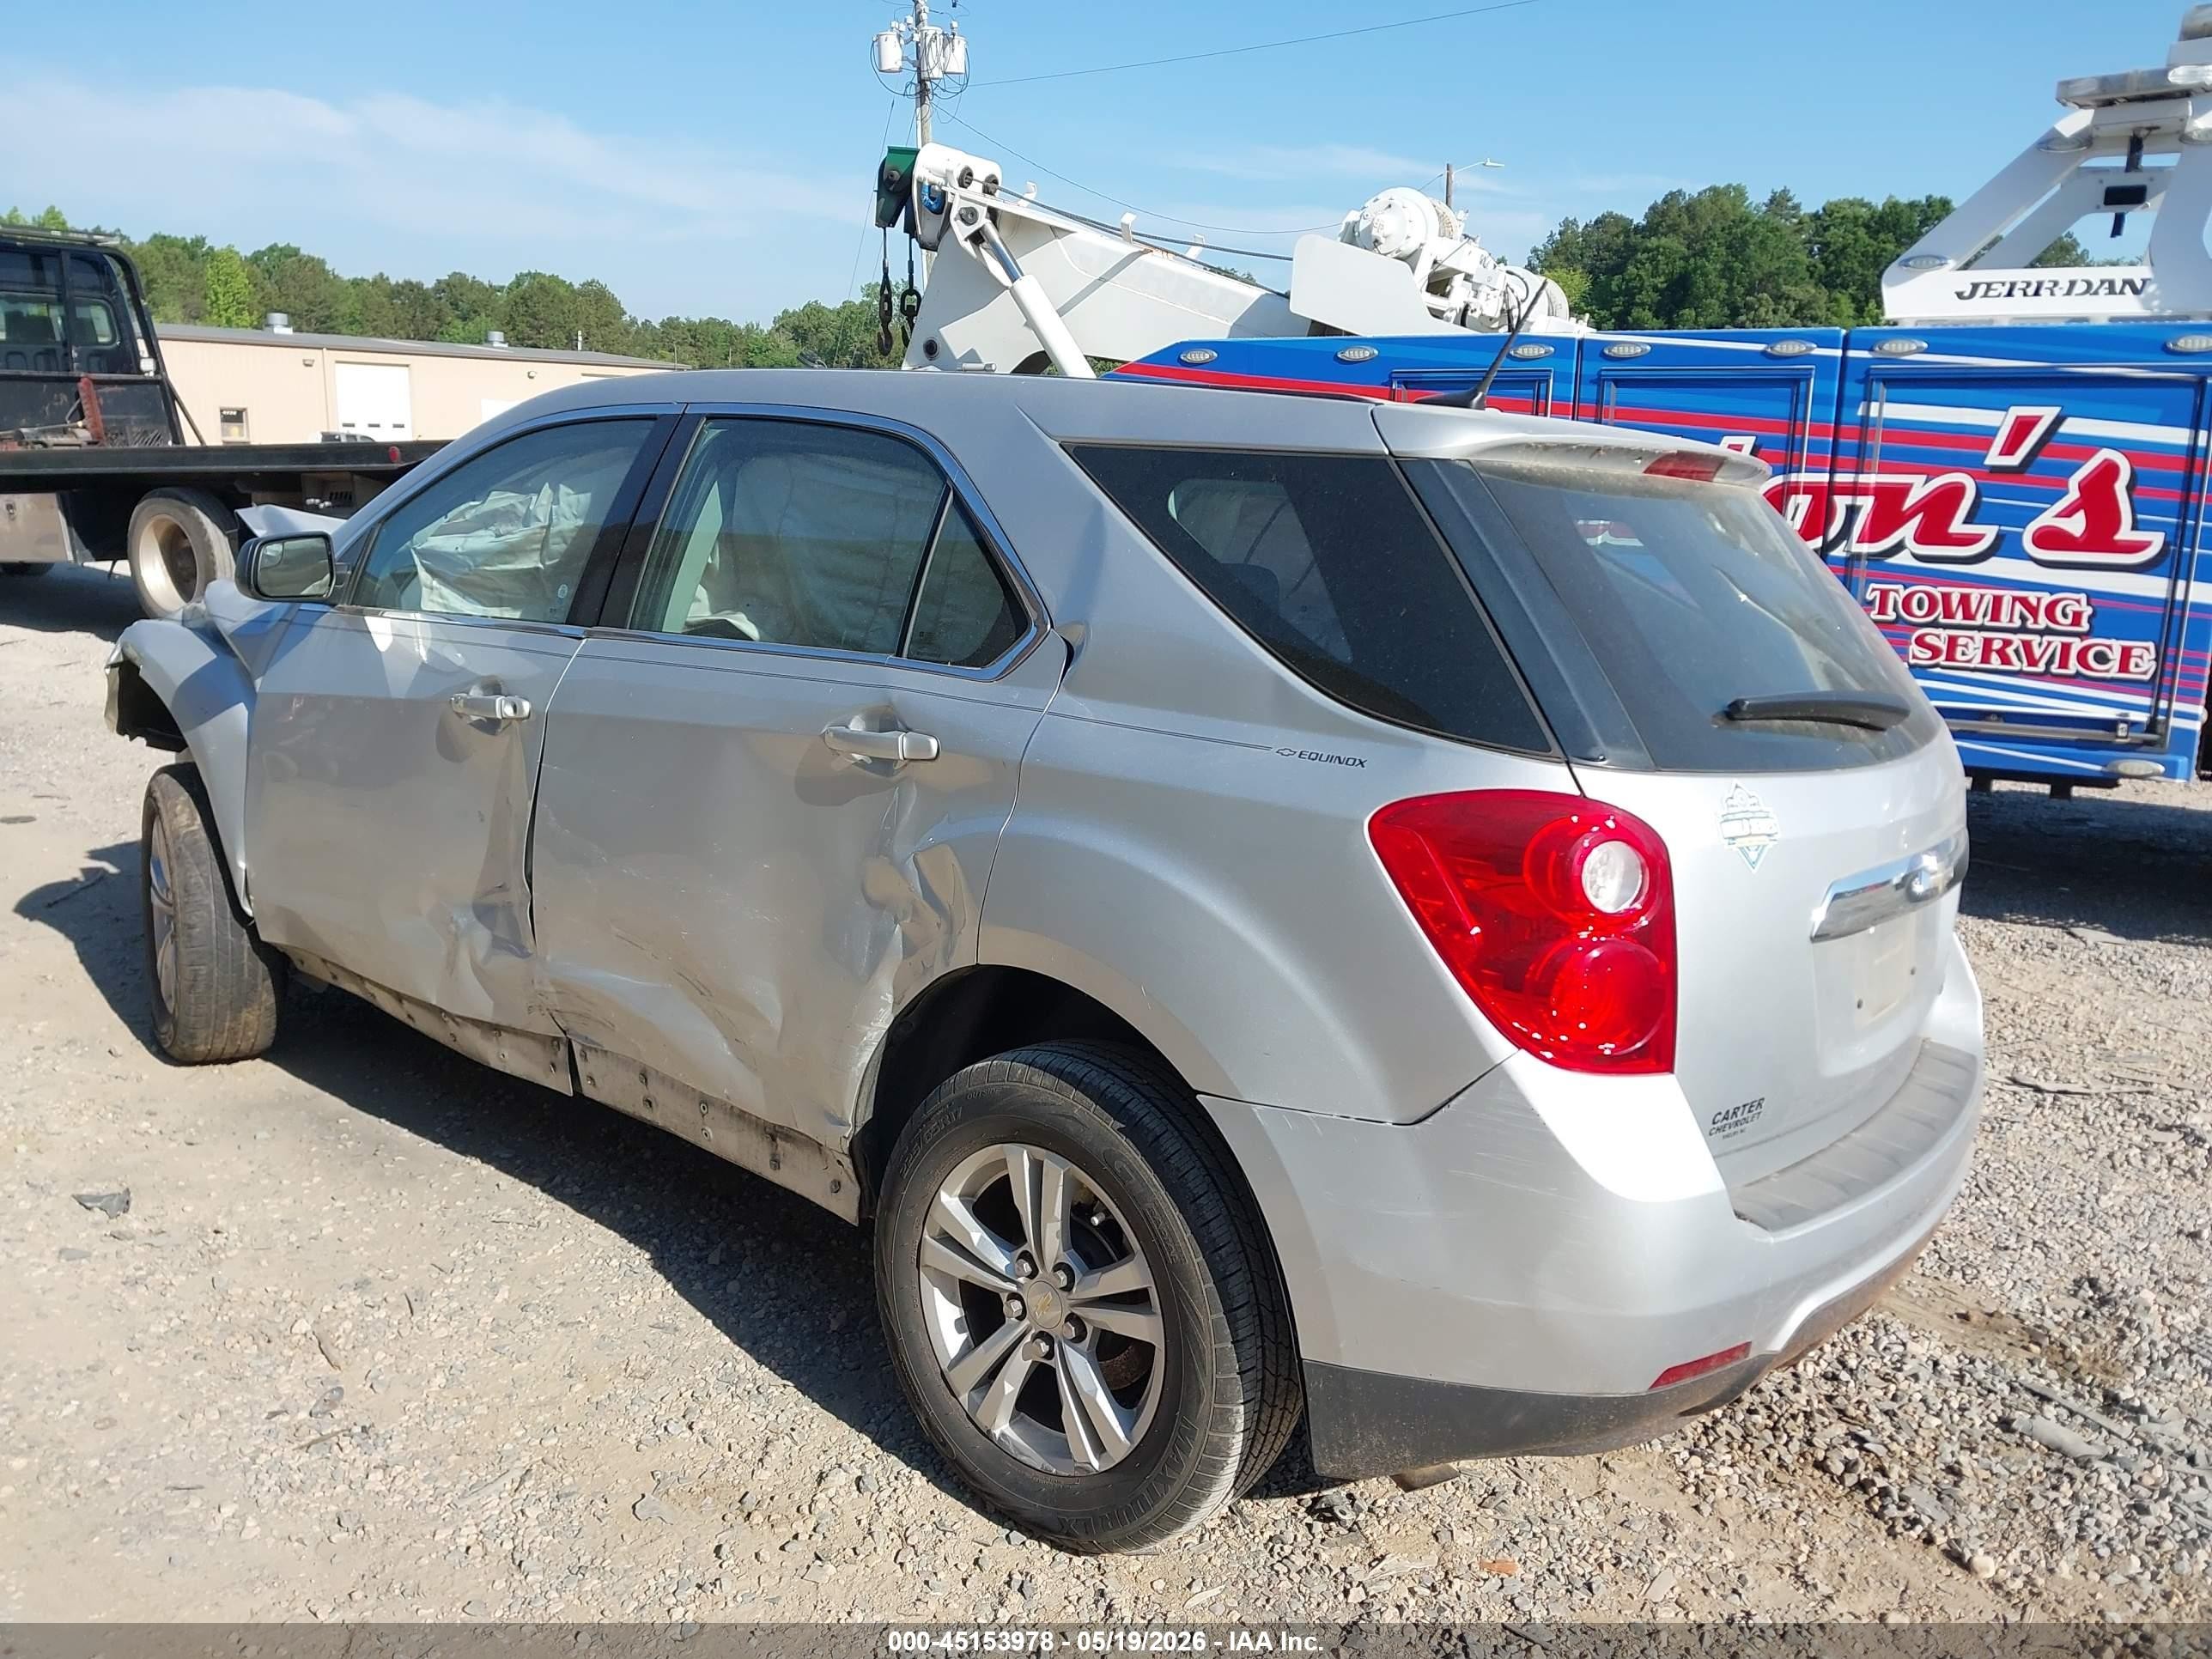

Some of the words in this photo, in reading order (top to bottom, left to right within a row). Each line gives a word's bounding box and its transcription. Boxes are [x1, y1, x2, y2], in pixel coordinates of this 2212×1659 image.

[1954, 277, 2153, 301] JERR-DAN
[1720, 405, 2166, 565] on's
[1866, 583, 2094, 631] TOWING
[1909, 628, 2158, 680] SERVICE
[1297, 750, 1368, 769] EQUINOX
[1708, 1110, 1763, 1137] CHEVROLET
[1711, 1097, 1765, 1126] CARTER
